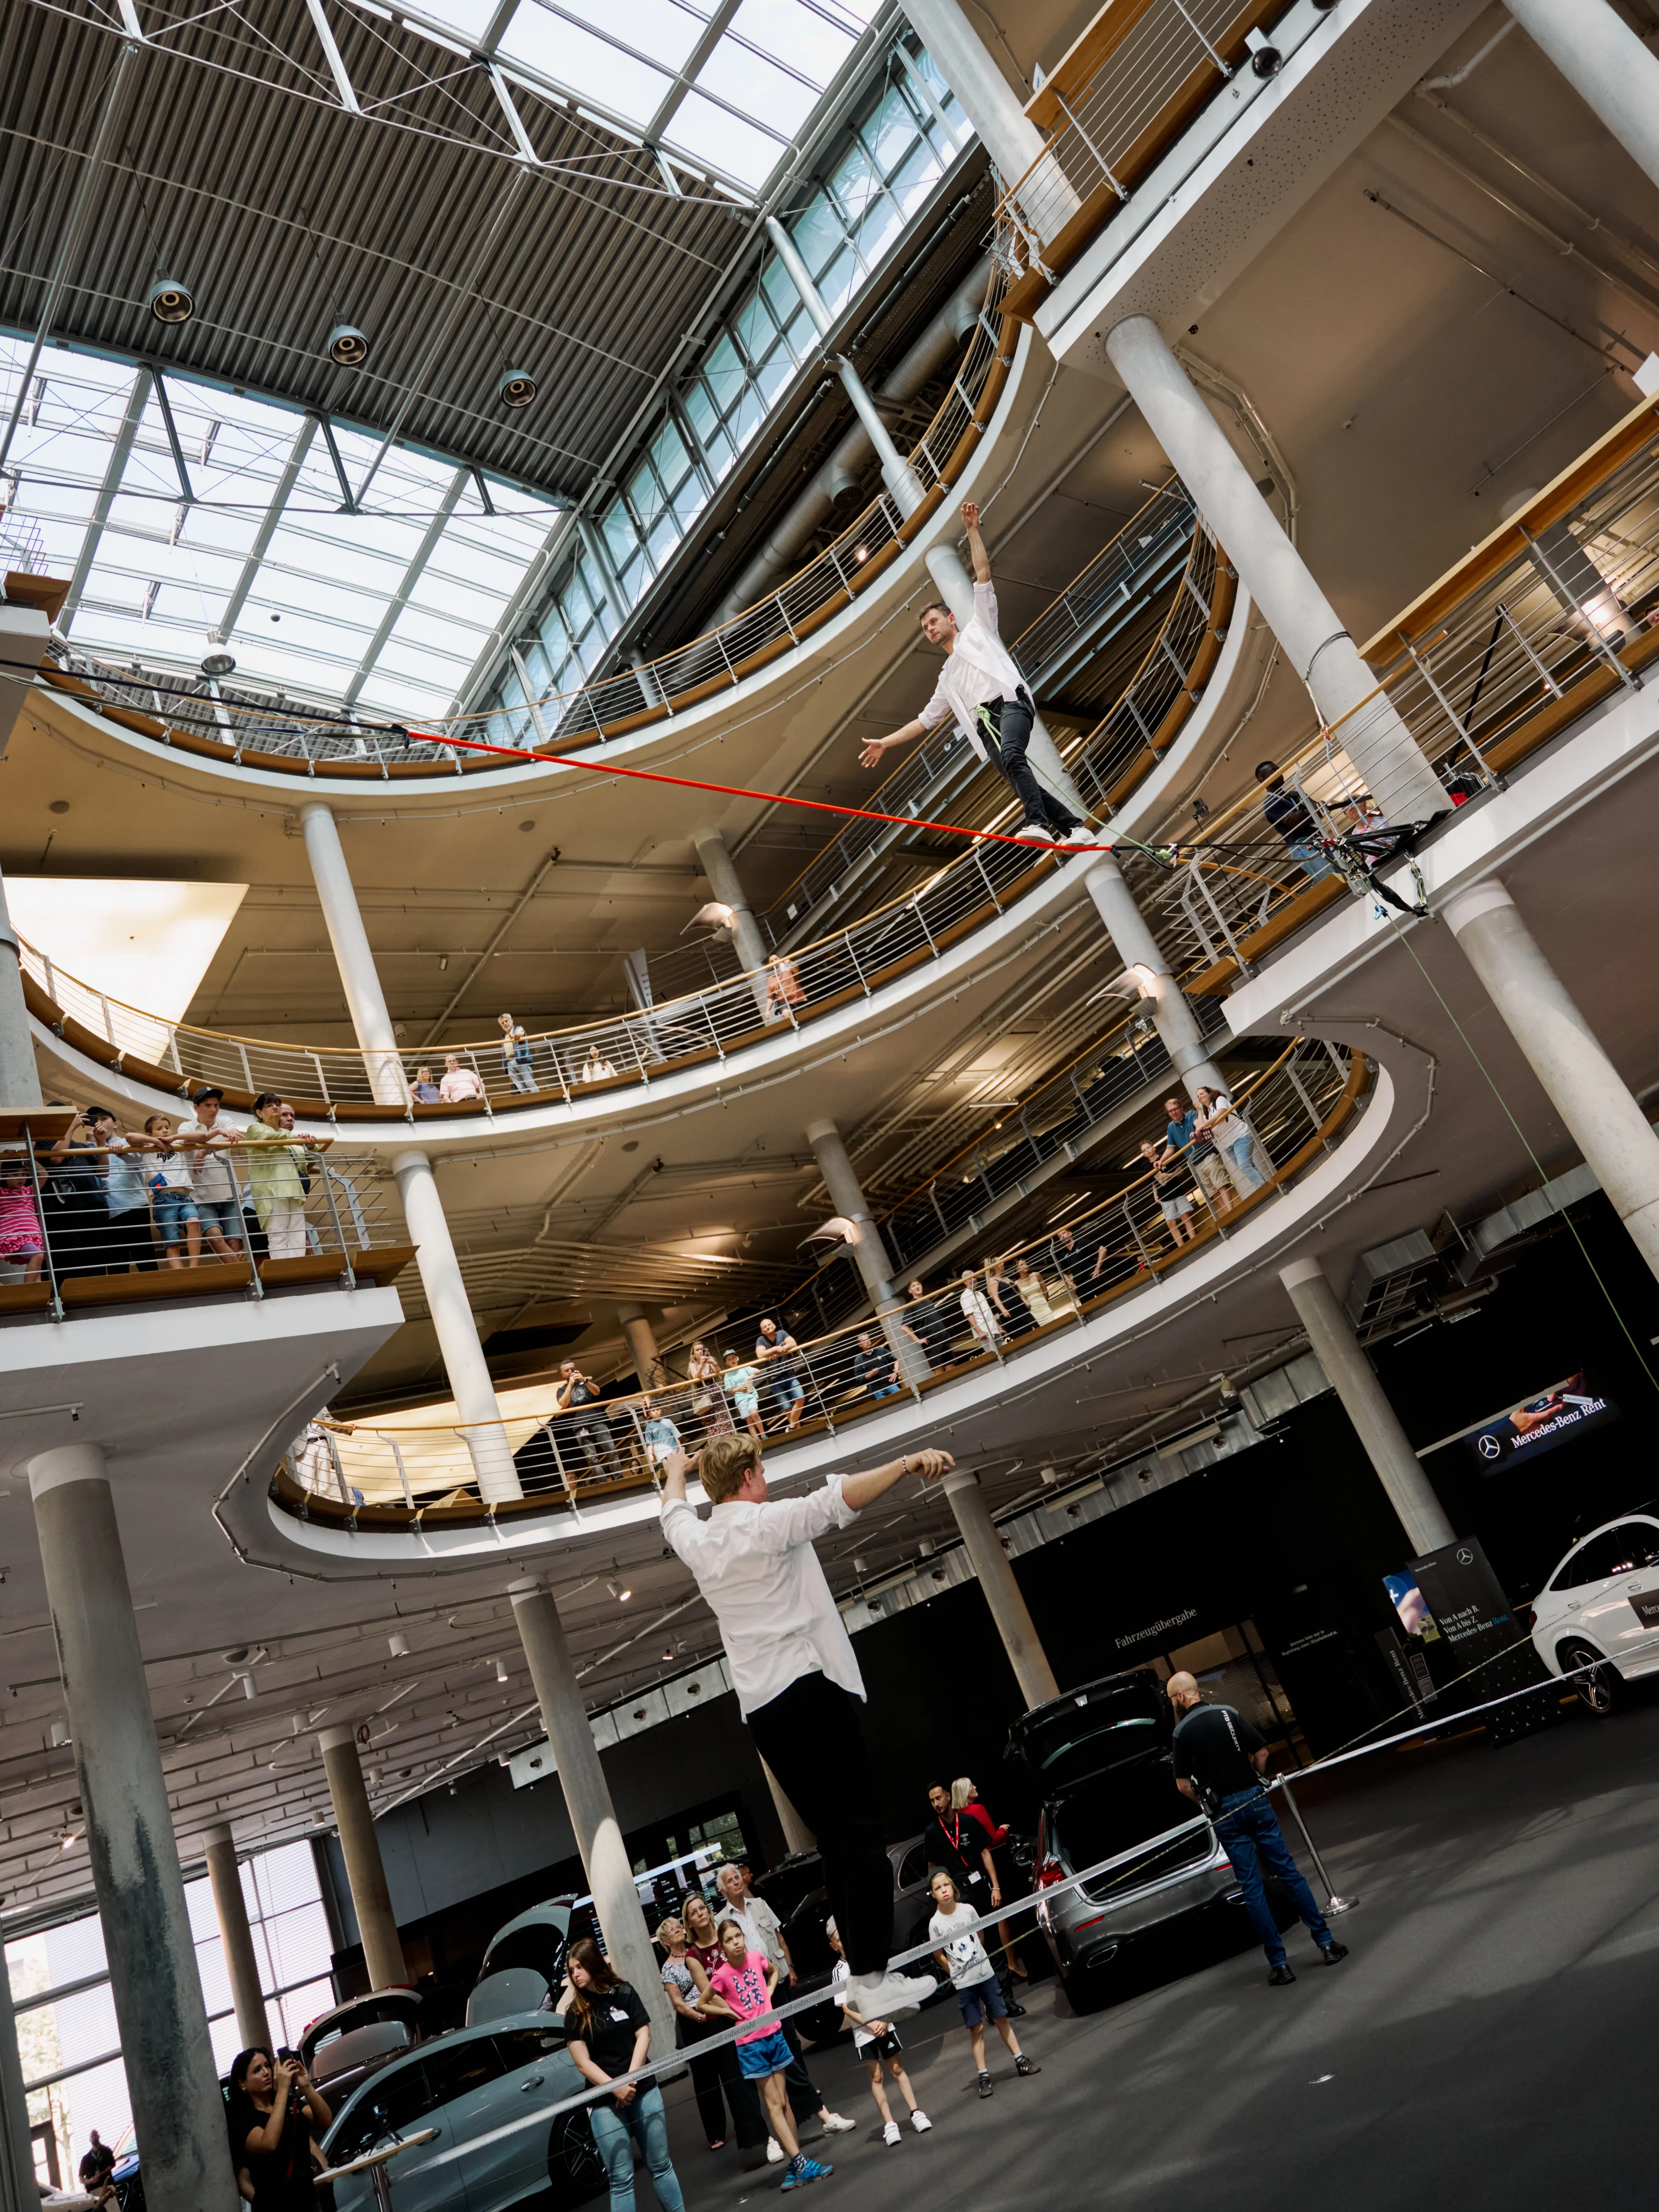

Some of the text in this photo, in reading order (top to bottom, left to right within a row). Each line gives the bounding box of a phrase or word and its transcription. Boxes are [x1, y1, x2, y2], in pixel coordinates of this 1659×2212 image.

[1350, 849, 1363, 865] GIBBON
[1511, 1398, 1606, 1448] Mercedes-Benz Rent
[1439, 1616, 1452, 1626] Von
[1457, 1607, 1472, 1619] nach
[1471, 1605, 1480, 1613] B.
[1443, 1625, 1457, 1634] Von
[1461, 1619, 1471, 1628] bis
[1115, 1607, 1197, 1649] Fahrzeugübergabe
[1448, 1614, 1509, 1643] Mercedes-Benz Rent.
[1390, 1650, 1400, 1667] Rent
[1221, 1710, 1241, 1751] PTB-SECURITY
[733, 1968, 757, 1993] LO
[738, 1986, 764, 2010] VE
